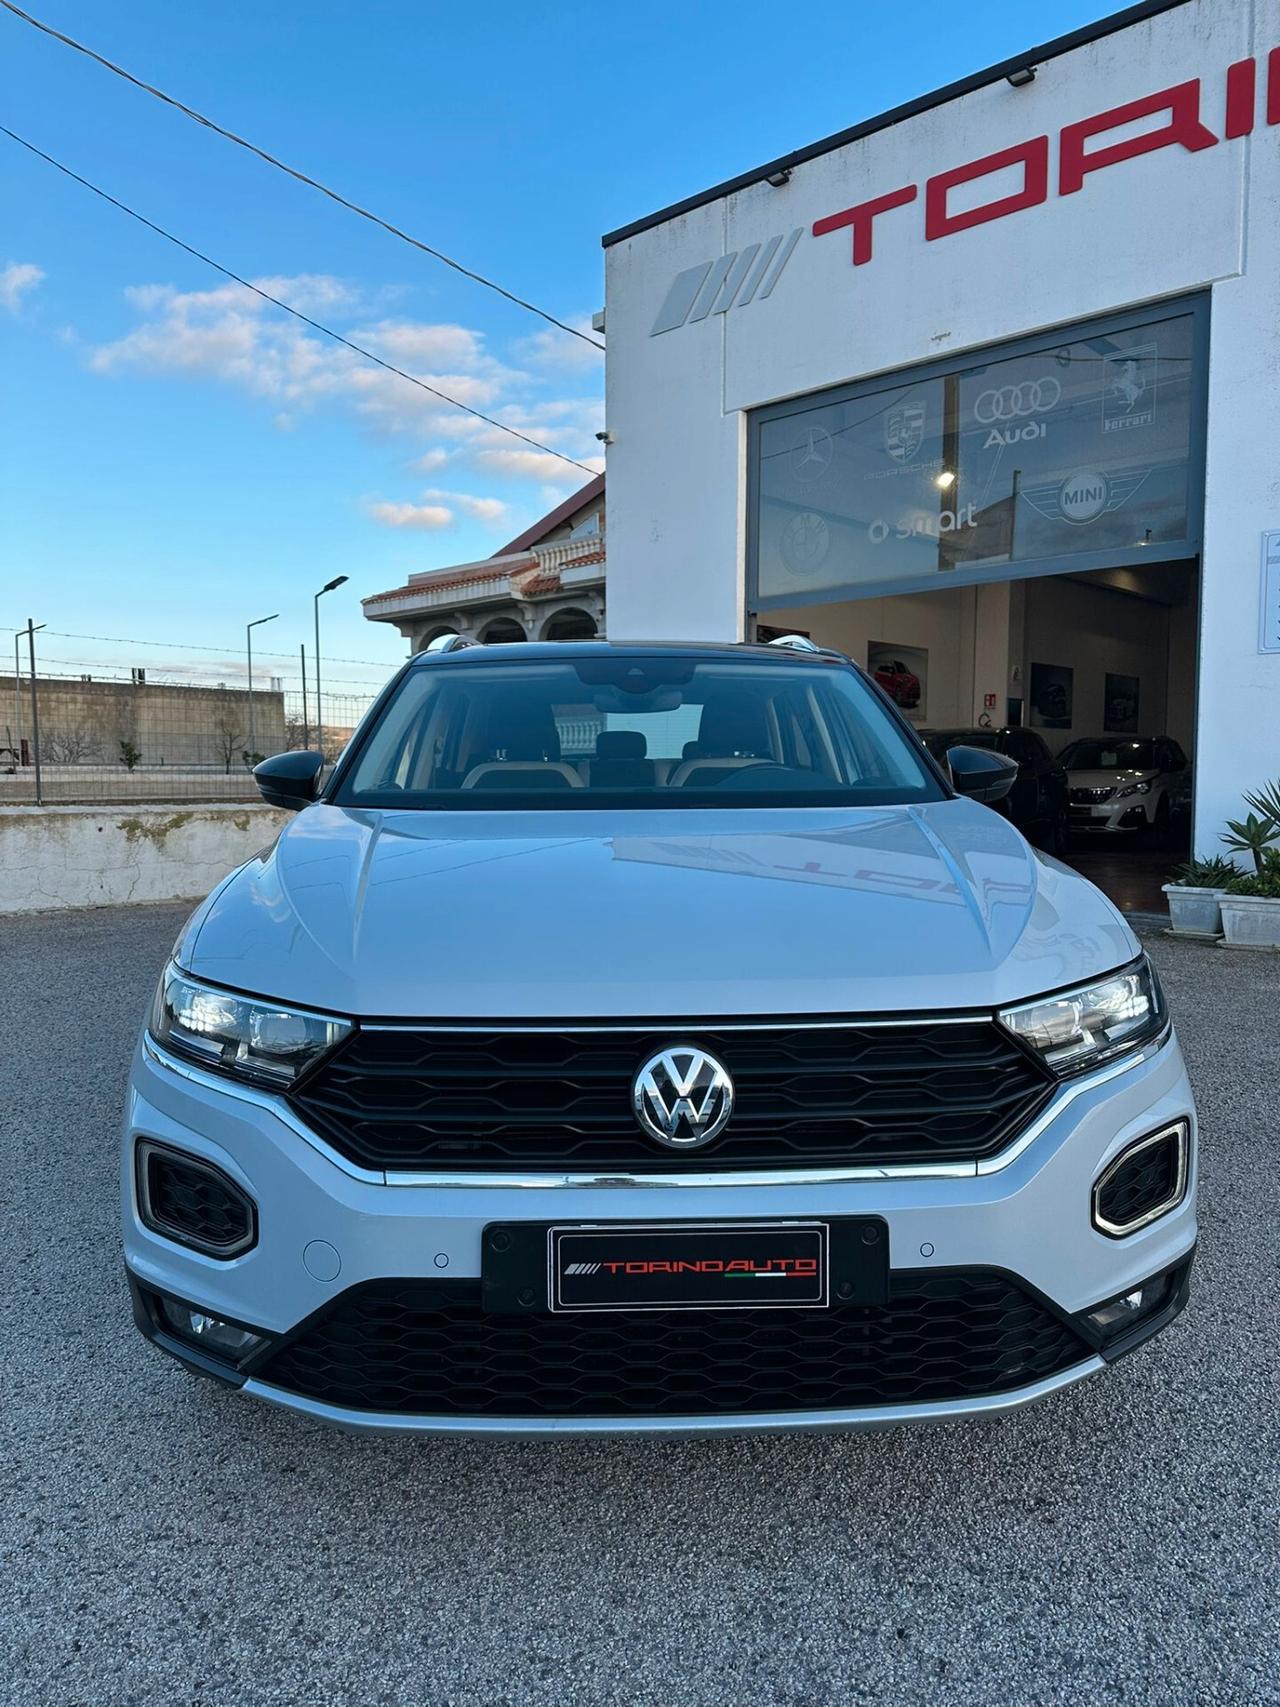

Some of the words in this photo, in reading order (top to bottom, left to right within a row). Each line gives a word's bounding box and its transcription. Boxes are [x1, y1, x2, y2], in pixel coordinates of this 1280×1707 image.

[1104, 413, 1152, 430] Ferrari
[983, 421, 1047, 449] Audi
[1064, 486, 1103, 506] MINI
[895, 502, 978, 539] smart
[634, 1047, 734, 1149] VW
[602, 1259, 817, 1275] TORINOAUTO
